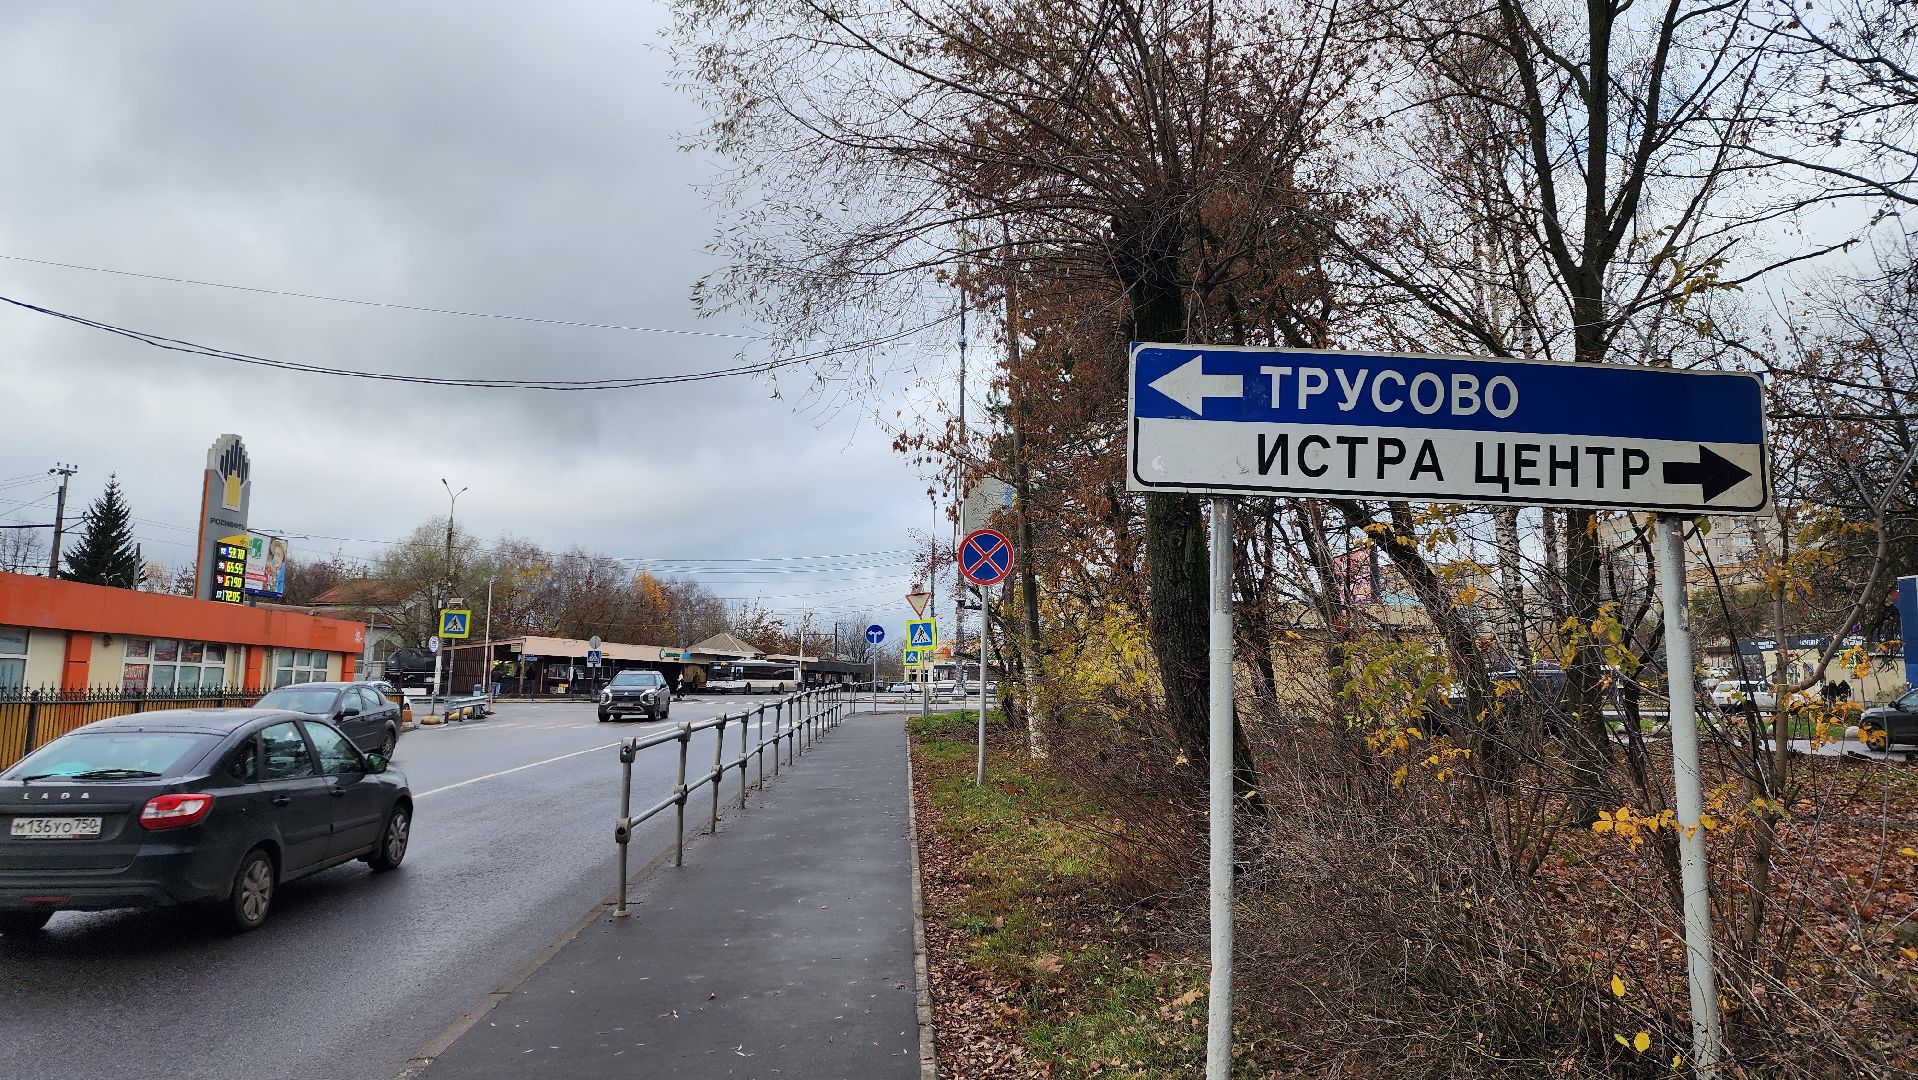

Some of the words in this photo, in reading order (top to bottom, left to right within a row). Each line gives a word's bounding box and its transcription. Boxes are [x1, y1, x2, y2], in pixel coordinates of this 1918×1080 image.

[1260, 365, 1519, 419] ТРУСОВО
[1257, 433, 1444, 482] ИСТРА
[1474, 442, 1650, 494] ЦЕНТР
[23, 792, 90, 800] LADA
